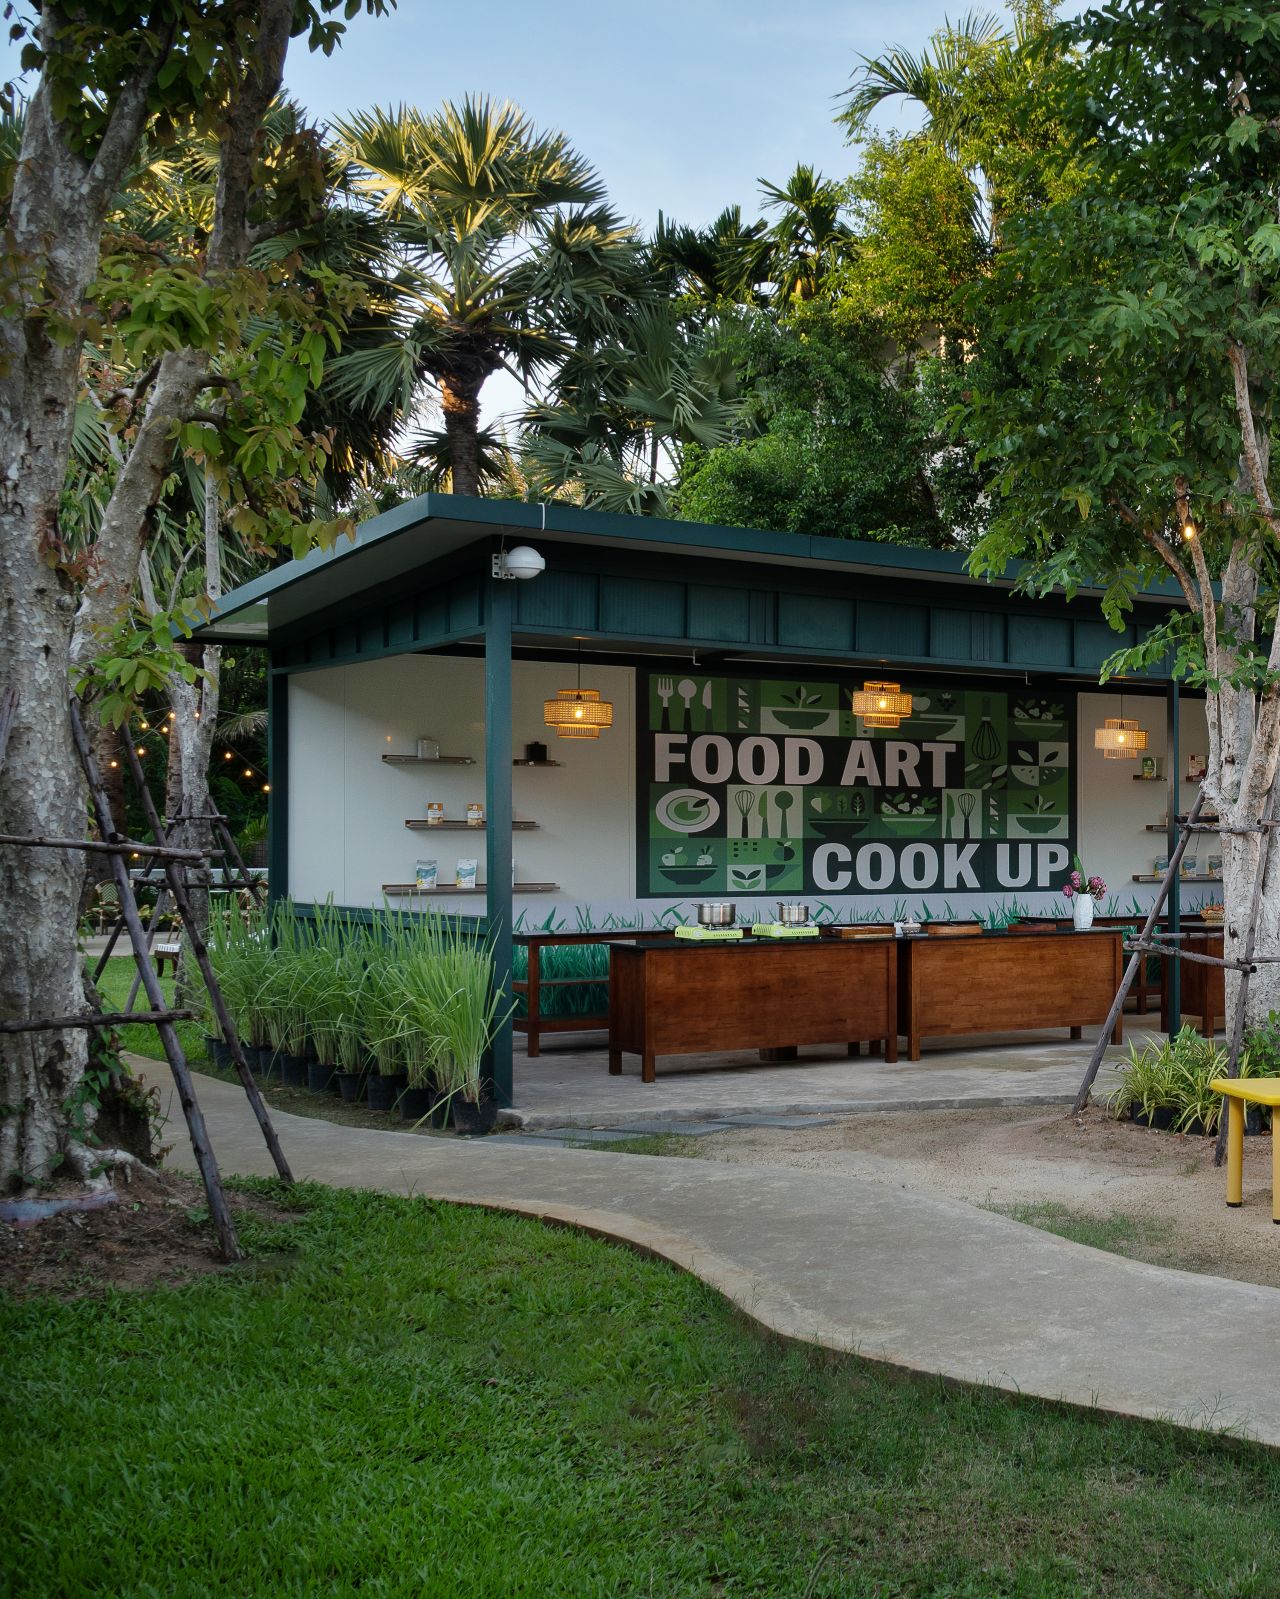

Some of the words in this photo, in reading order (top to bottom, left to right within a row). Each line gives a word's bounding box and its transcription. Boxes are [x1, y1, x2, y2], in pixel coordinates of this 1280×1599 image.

[655, 734, 824, 784] FOOD
[840, 740, 956, 788] ART
[812, 843, 981, 890] COOK
[997, 844, 1069, 888] UP
